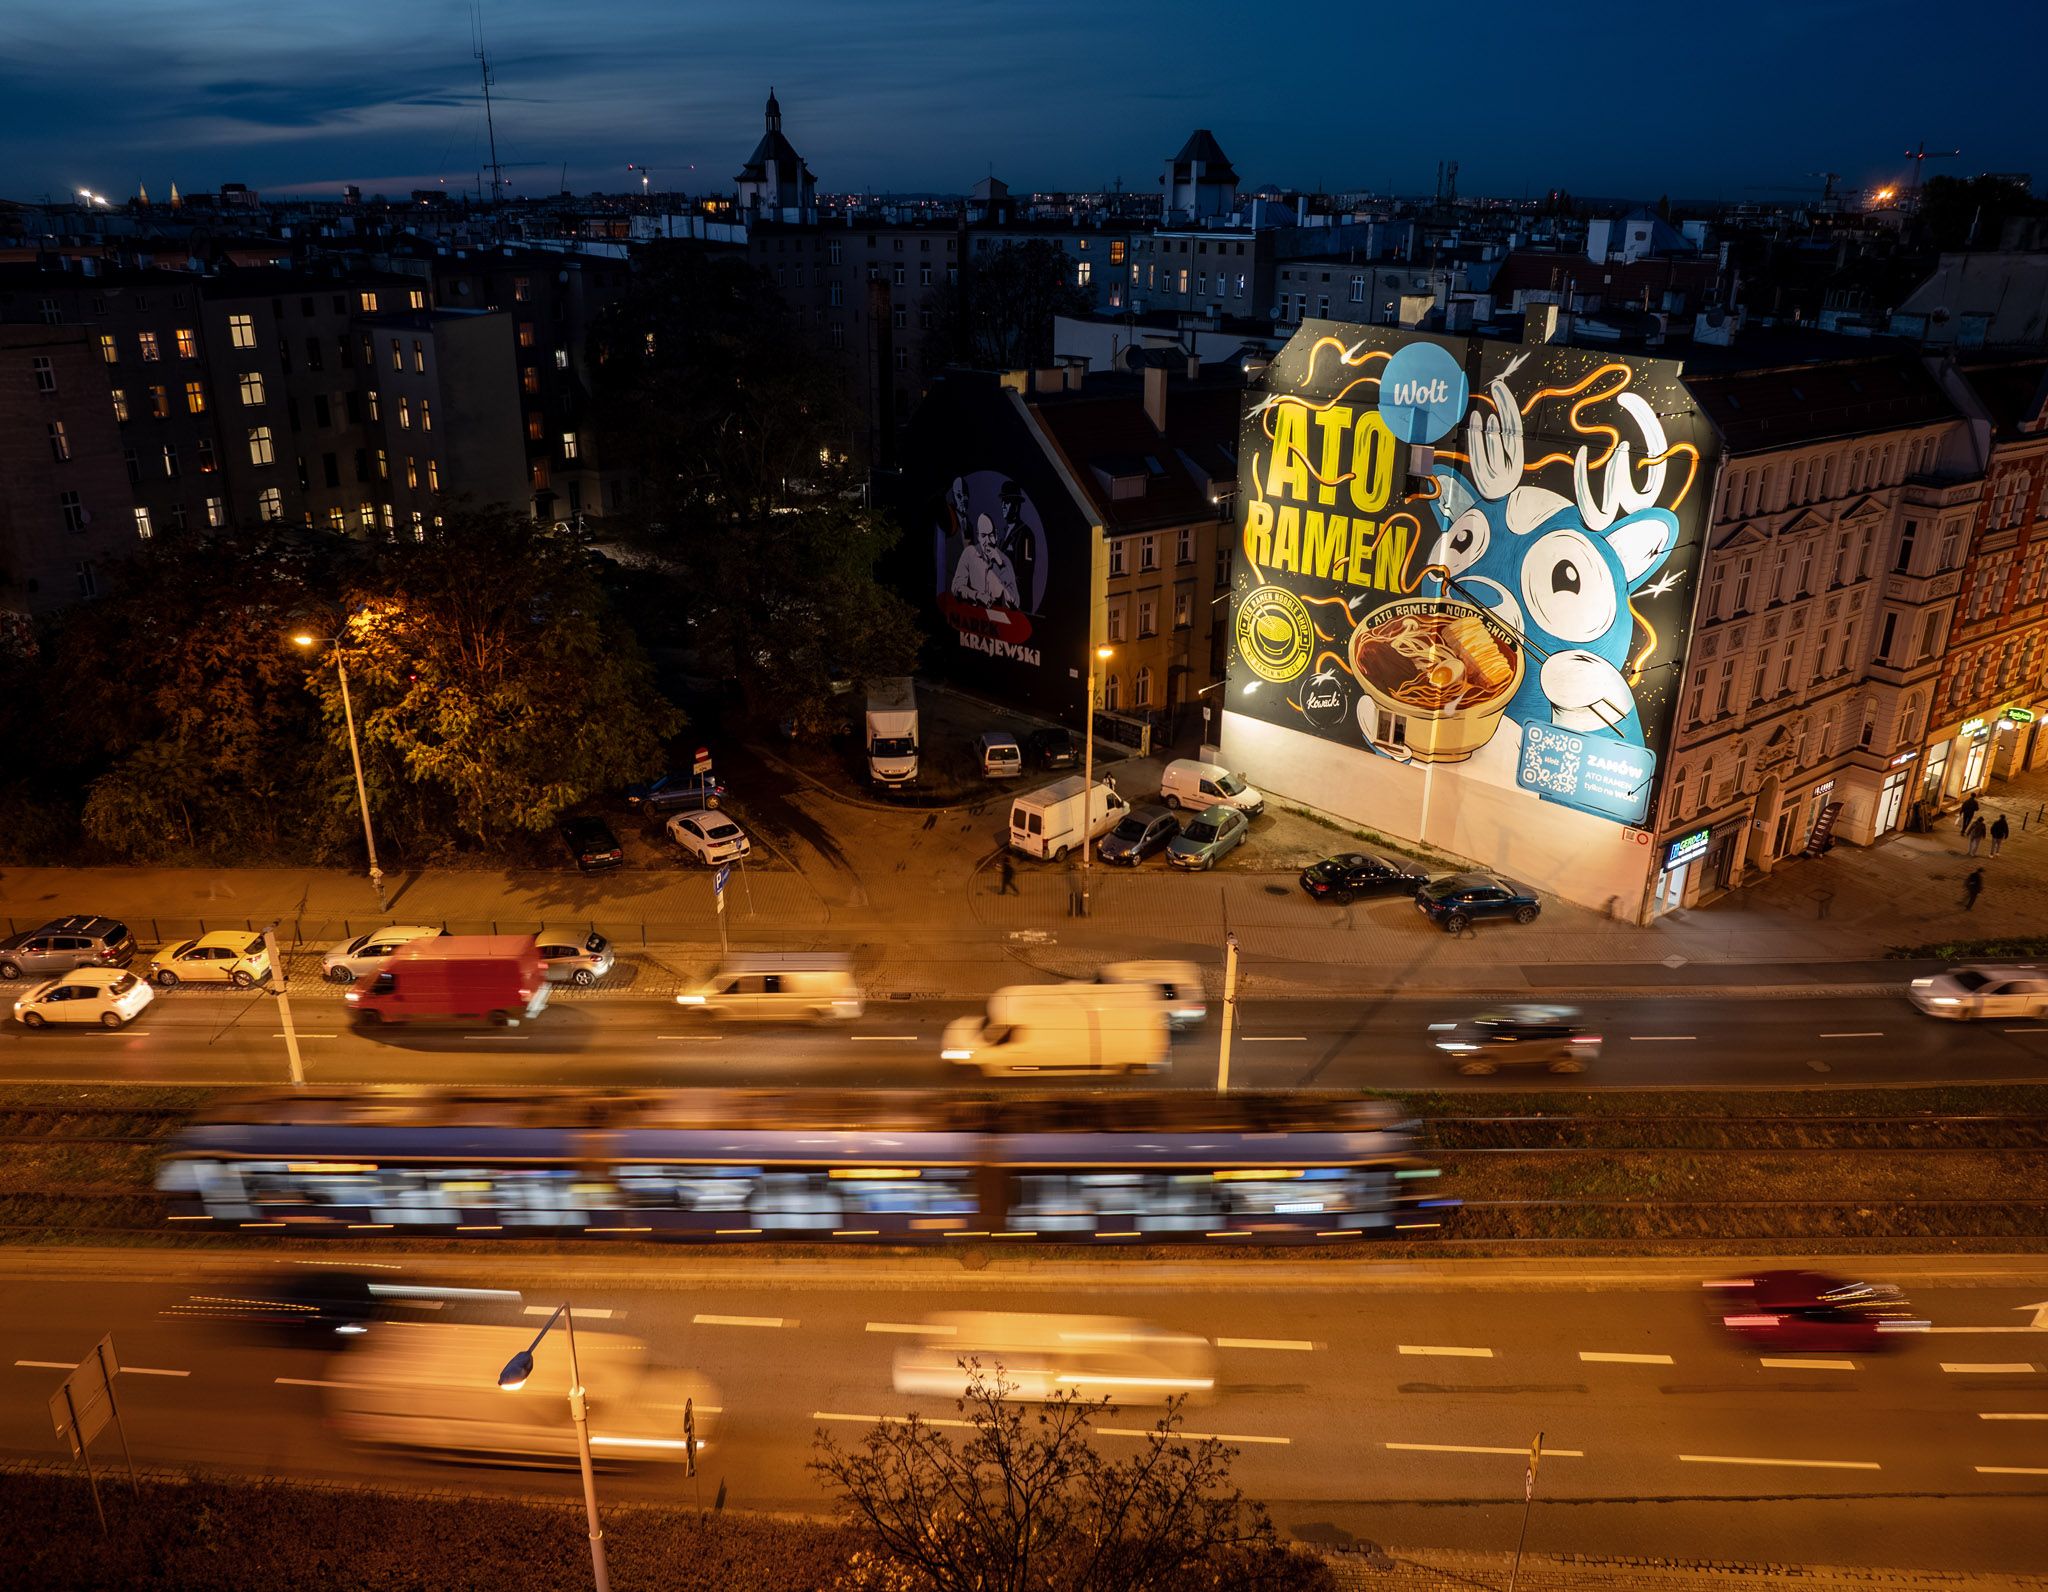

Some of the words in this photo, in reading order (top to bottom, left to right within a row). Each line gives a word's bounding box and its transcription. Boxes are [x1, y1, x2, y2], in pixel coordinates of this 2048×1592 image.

[1394, 379, 1448, 406] Wolt
[1266, 403, 1396, 513] ATO
[1248, 500, 1409, 594] RAMEN
[1243, 605, 1254, 621] ATO
[1251, 592, 1273, 608] RAMEN
[1274, 593, 1300, 614] NOODLE
[1297, 614, 1309, 635] SHOP
[1374, 610, 1393, 626] ATO
[1396, 604, 1438, 616] RAMEN
[1587, 754, 1643, 779] ZAMÓW
[1584, 771, 1602, 782] ATO
[1602, 774, 1633, 788] RAMEN
[1584, 782, 1603, 793] tylko
[1603, 788, 1614, 796] na
[716, 872, 722, 889] P
